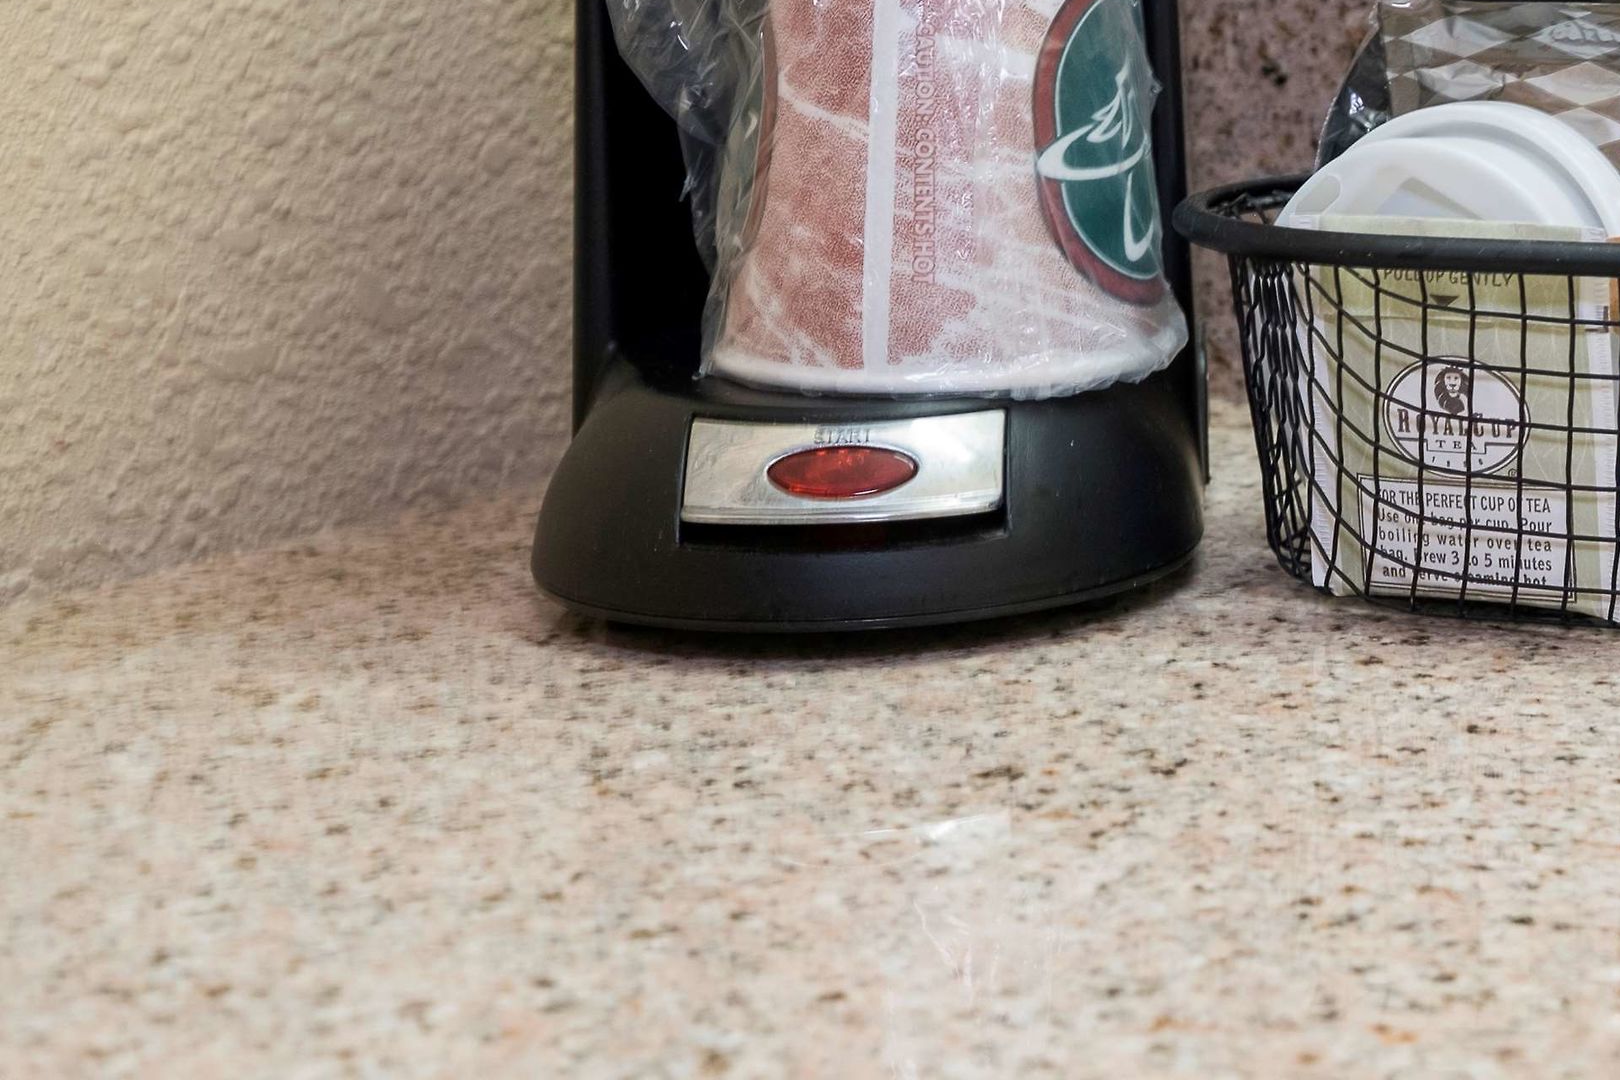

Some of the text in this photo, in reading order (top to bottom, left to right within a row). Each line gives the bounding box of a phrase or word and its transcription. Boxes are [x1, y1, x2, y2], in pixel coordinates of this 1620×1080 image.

[914, 127, 937, 237] CONTENTS
[911, 239, 937, 286] HOT
[1425, 492, 1478, 510] PERFET
[1480, 495, 1505, 512] CUP
[1525, 497, 1552, 514] TEA
[1520, 517, 1553, 534] Pour
[1437, 533, 1479, 549] watr
[1527, 538, 1552, 552] tea
[1451, 550, 1460, 566] 3
[1484, 552, 1493, 568] 5
[1382, 565, 1407, 578] and
[1413, 569, 1449, 582] erve
[1453, 570, 1517, 589] seaming
